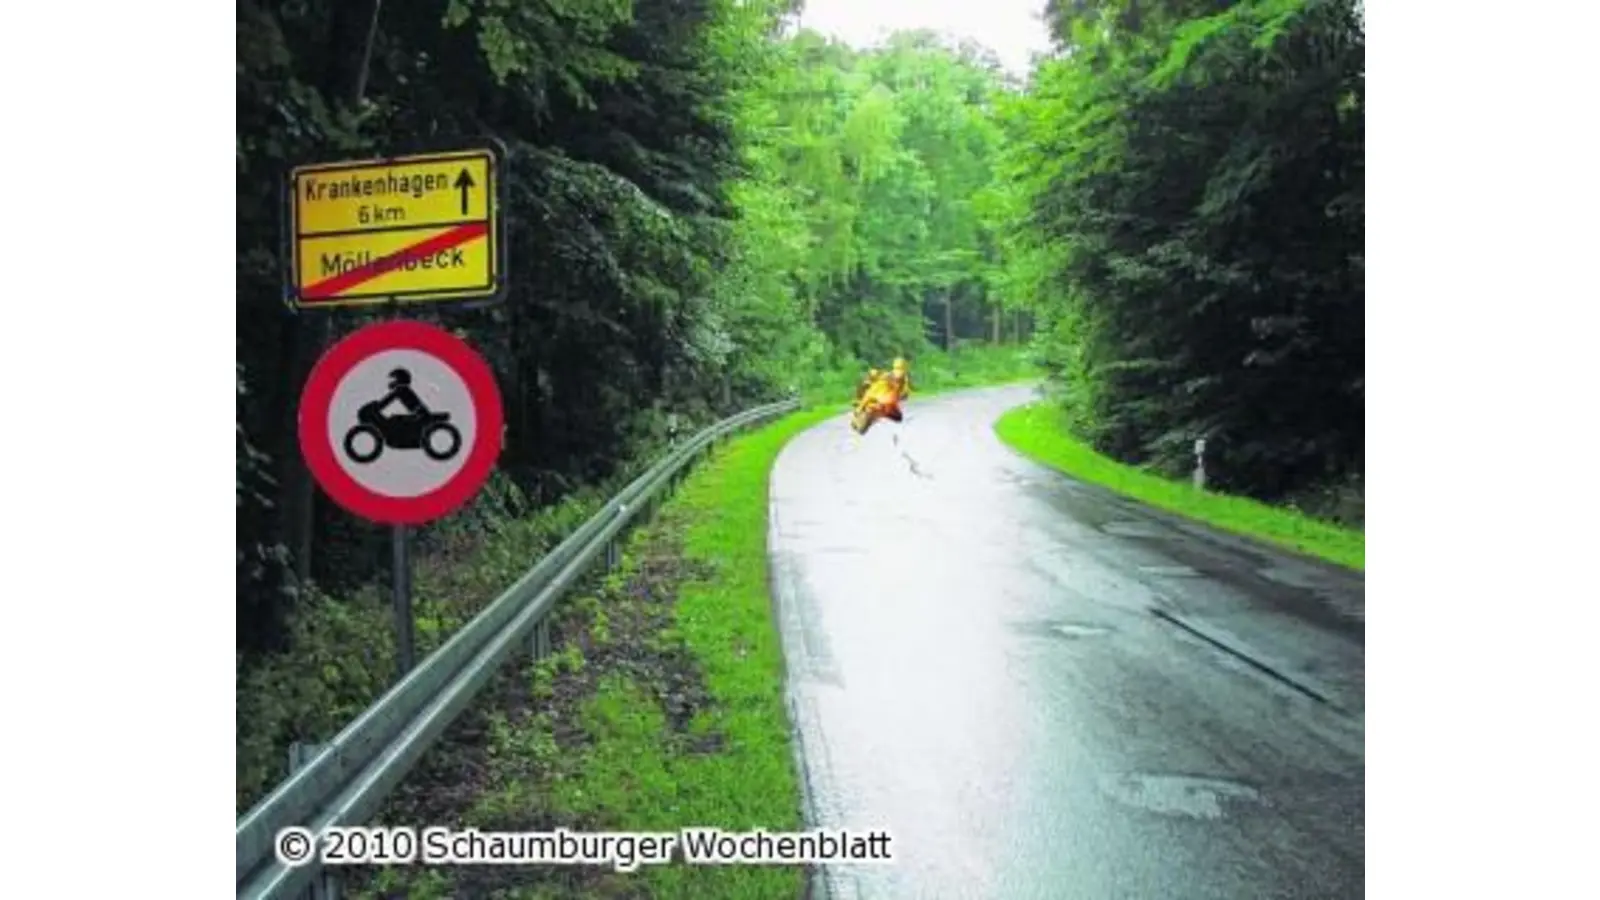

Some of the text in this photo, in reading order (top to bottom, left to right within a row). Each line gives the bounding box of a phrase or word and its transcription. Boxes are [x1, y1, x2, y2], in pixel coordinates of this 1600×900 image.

[305, 172, 448, 201] Krankenhagen
[357, 205, 406, 224] 6 km
[320, 248, 465, 277] Möllbeck
